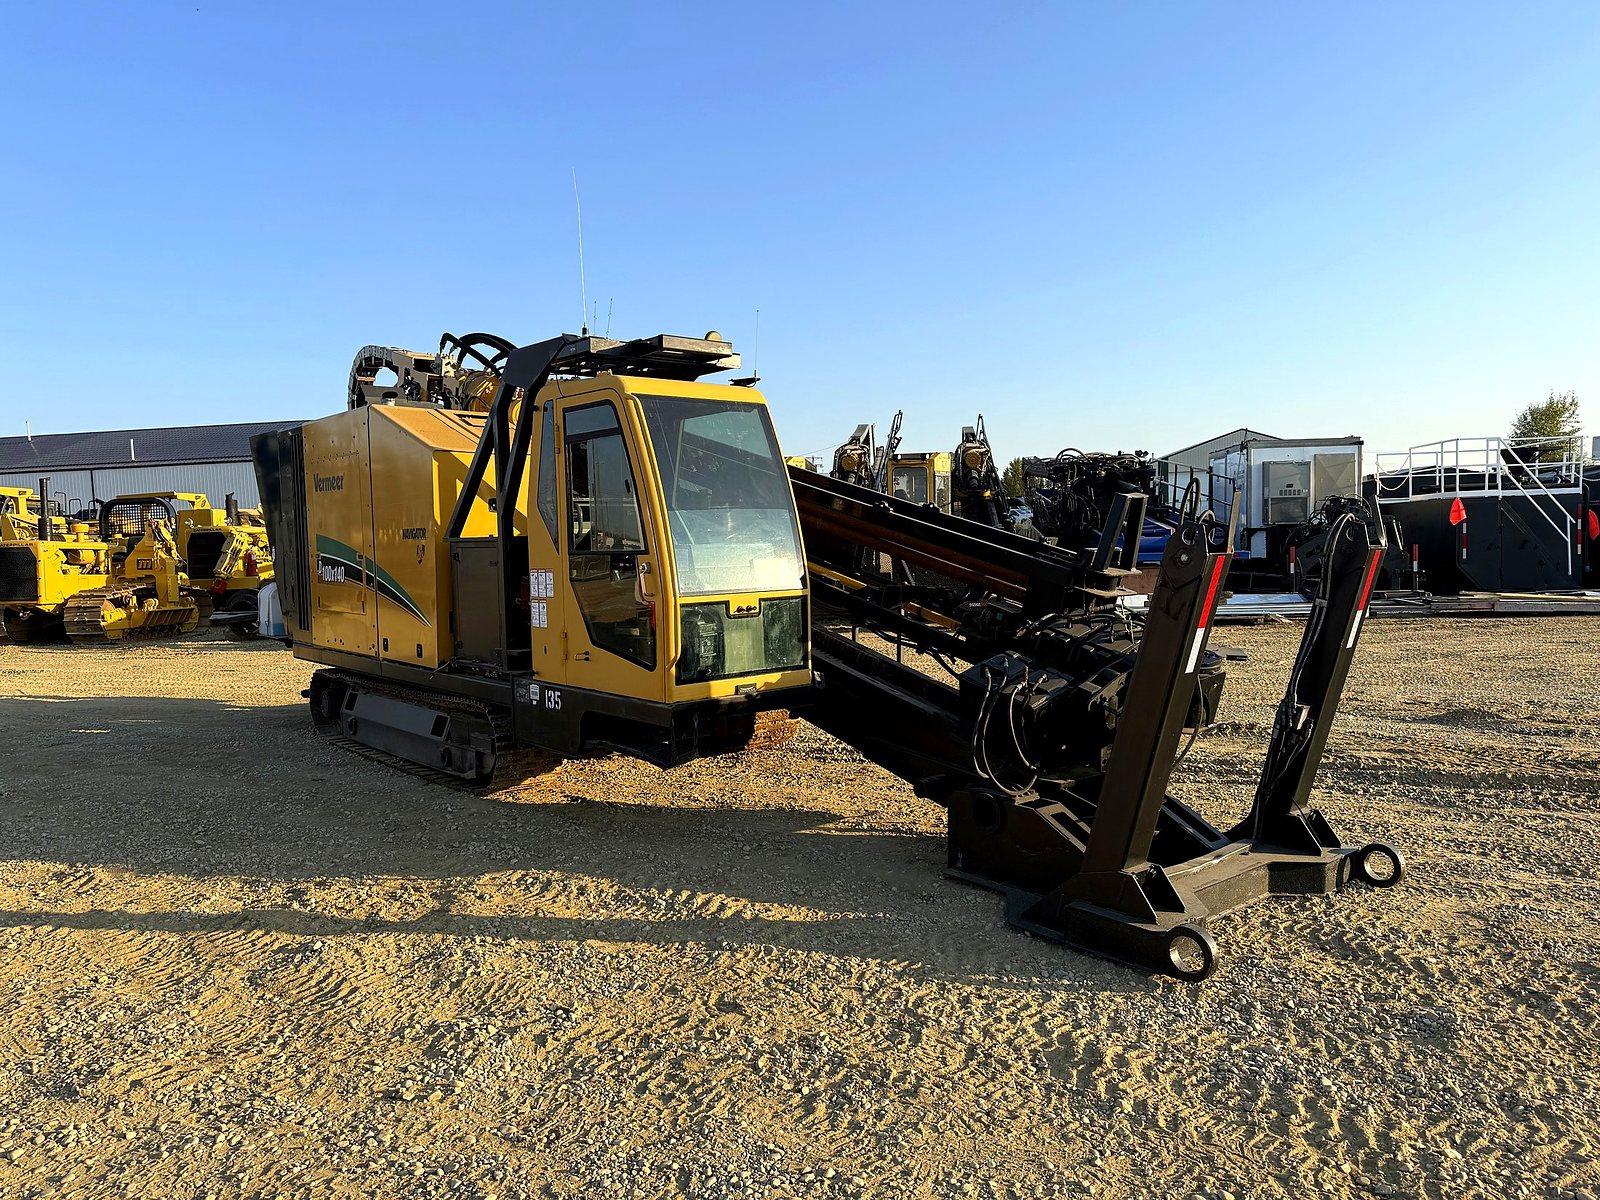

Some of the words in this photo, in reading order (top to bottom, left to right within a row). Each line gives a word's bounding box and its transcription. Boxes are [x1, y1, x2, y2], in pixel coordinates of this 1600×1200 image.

[313, 473, 344, 493] Vermeer
[402, 527, 427, 540] NAVIGATOR
[322, 565, 345, 583] 100x140
[544, 689, 562, 710] 135
